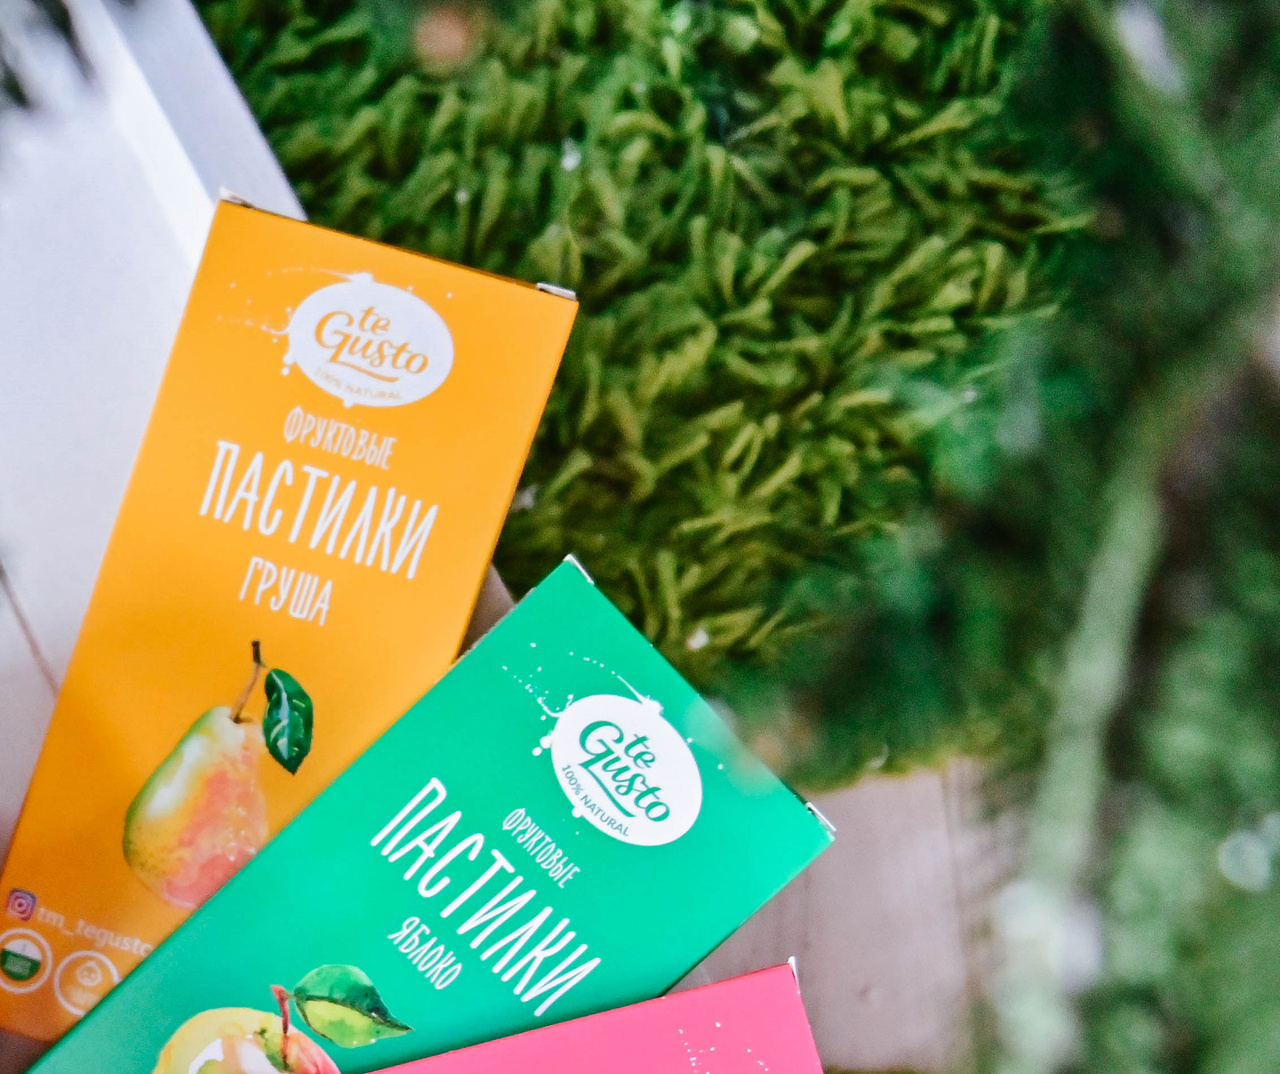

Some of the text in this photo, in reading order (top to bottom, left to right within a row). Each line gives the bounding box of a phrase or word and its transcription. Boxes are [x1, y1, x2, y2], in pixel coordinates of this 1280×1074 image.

[315, 310, 429, 383] Gusto
[361, 305, 390, 335] te
[284, 406, 397, 470] ФРУКТОВЫЕ
[200, 441, 439, 580] ПАСТИЛКИ
[239, 557, 332, 626] ГРУША
[579, 721, 671, 823] Gusto
[623, 733, 656, 769] te
[560, 764, 630, 837] 100% NATURAL
[502, 808, 581, 890] ФРУКТОВЫЕ
[370, 778, 601, 1016] ПАСТИЛКИ
[388, 916, 464, 990] ЯБЛОКО
